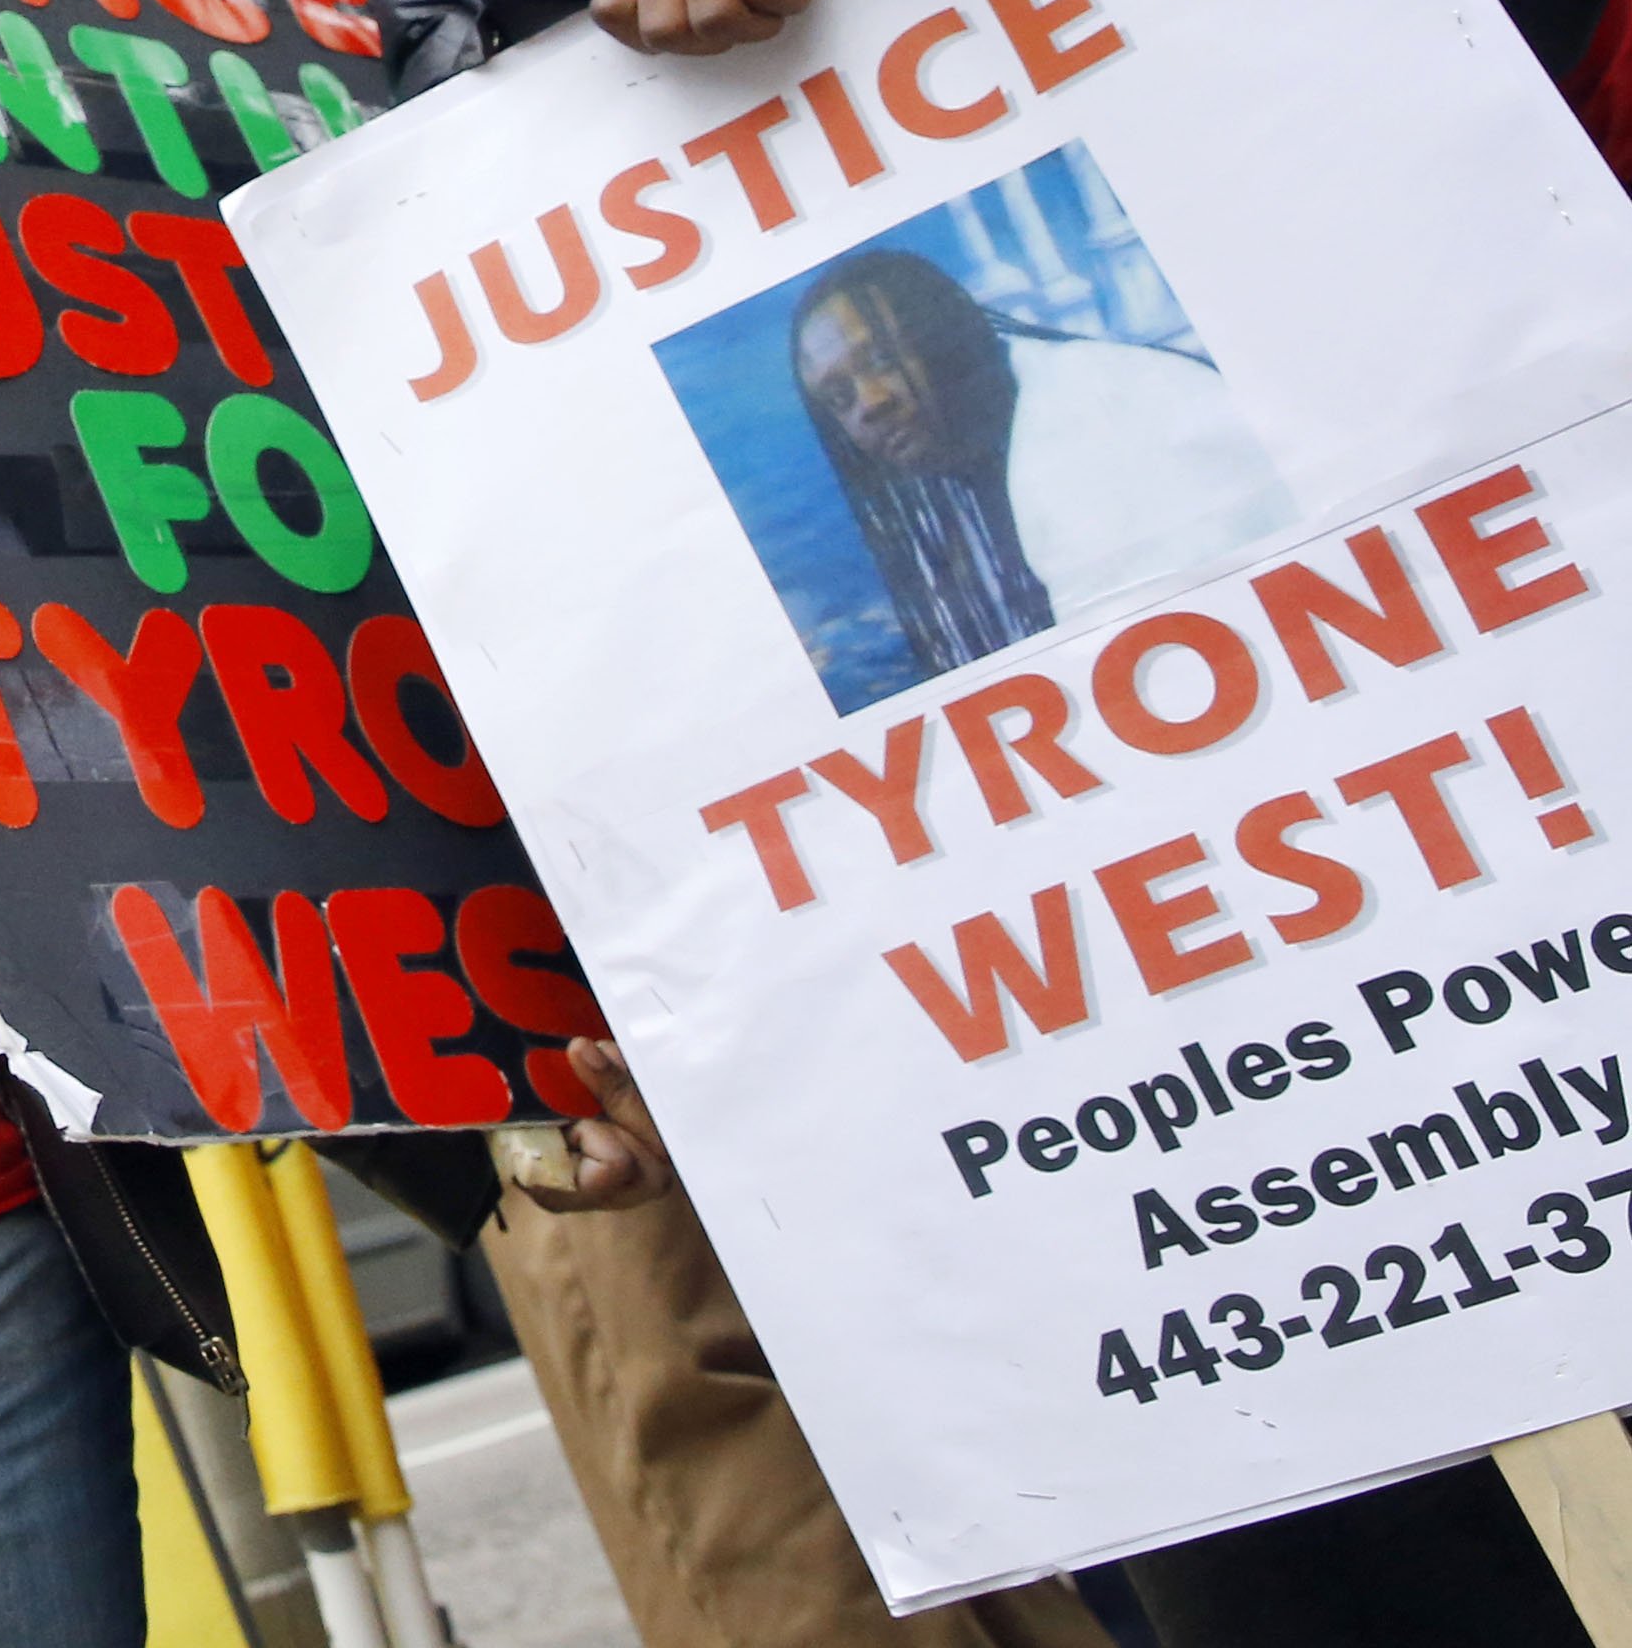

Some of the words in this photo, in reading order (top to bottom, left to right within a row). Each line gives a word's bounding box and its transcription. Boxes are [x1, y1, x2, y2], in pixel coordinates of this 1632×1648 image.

[70, 390, 374, 593] FO
[699, 464, 1589, 913] TYRONE
[111, 884, 609, 1132] WES
[883, 705, 1595, 1065] WEST!
[942, 1021, 1352, 1198] Peoples
[1357, 913, 1632, 1054] Powe
[1133, 1054, 1631, 1269] Assembly
[1096, 1168, 1632, 1405] 443-221-37
